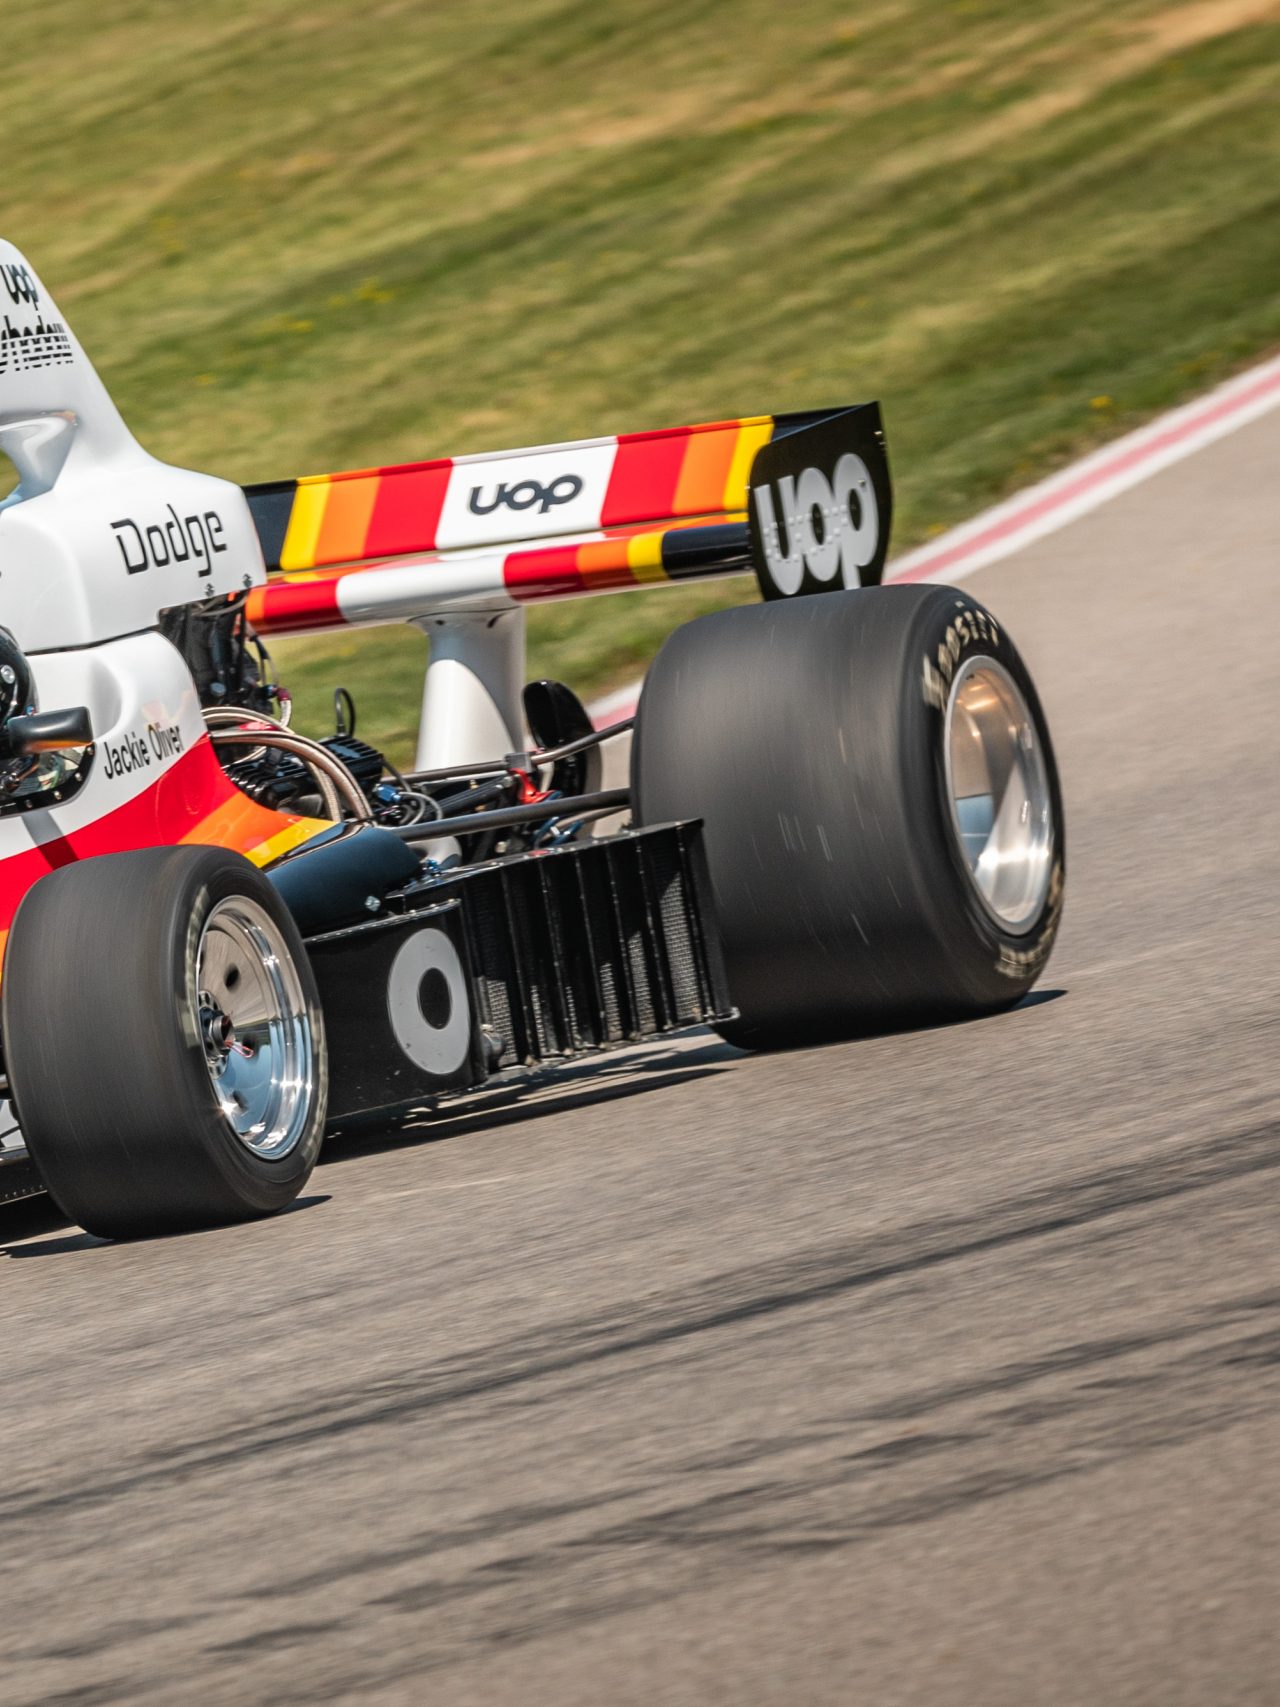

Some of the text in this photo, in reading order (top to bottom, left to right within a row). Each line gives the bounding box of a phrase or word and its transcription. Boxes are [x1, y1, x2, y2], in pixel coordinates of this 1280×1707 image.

[110, 503, 228, 578] Dodge
[104, 722, 185, 780] Jackie Oliver
